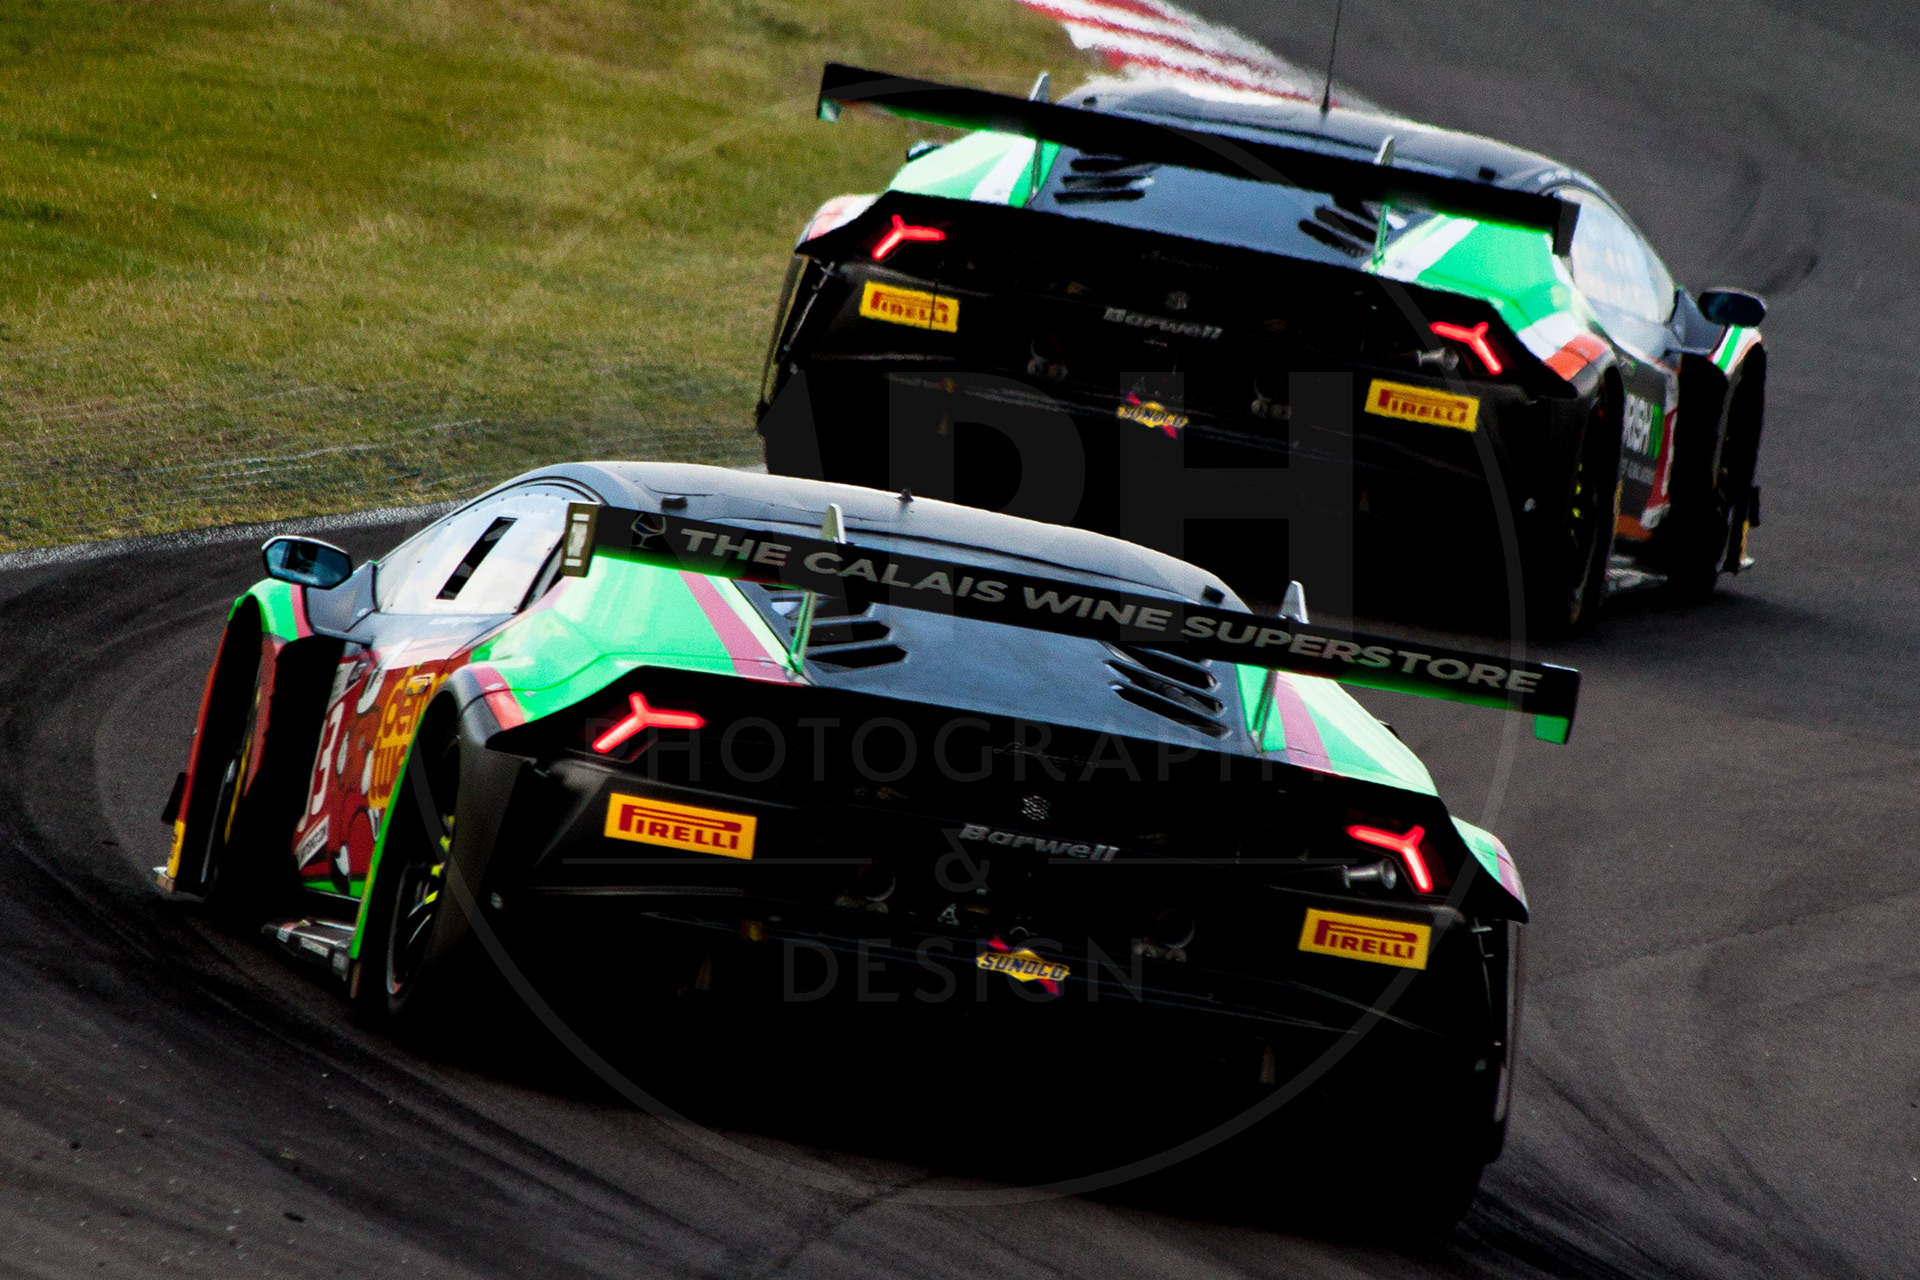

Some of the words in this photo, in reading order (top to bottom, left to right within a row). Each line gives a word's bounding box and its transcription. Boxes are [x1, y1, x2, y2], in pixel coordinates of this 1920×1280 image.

[871, 291, 949, 325] PIRELLI
[1103, 306, 1223, 339] Barwell
[1378, 388, 1469, 423] PIRELLI
[681, 528, 791, 567] THE
[803, 552, 1006, 602] CALAIS
[1023, 587, 1173, 631] WINE
[1180, 616, 1543, 695] SUPERSTORE
[618, 803, 742, 850] PIRELLI
[958, 822, 1120, 862] Barwell
[1313, 919, 1419, 960] PIRELLI
[978, 951, 1068, 981] SUNOCO
